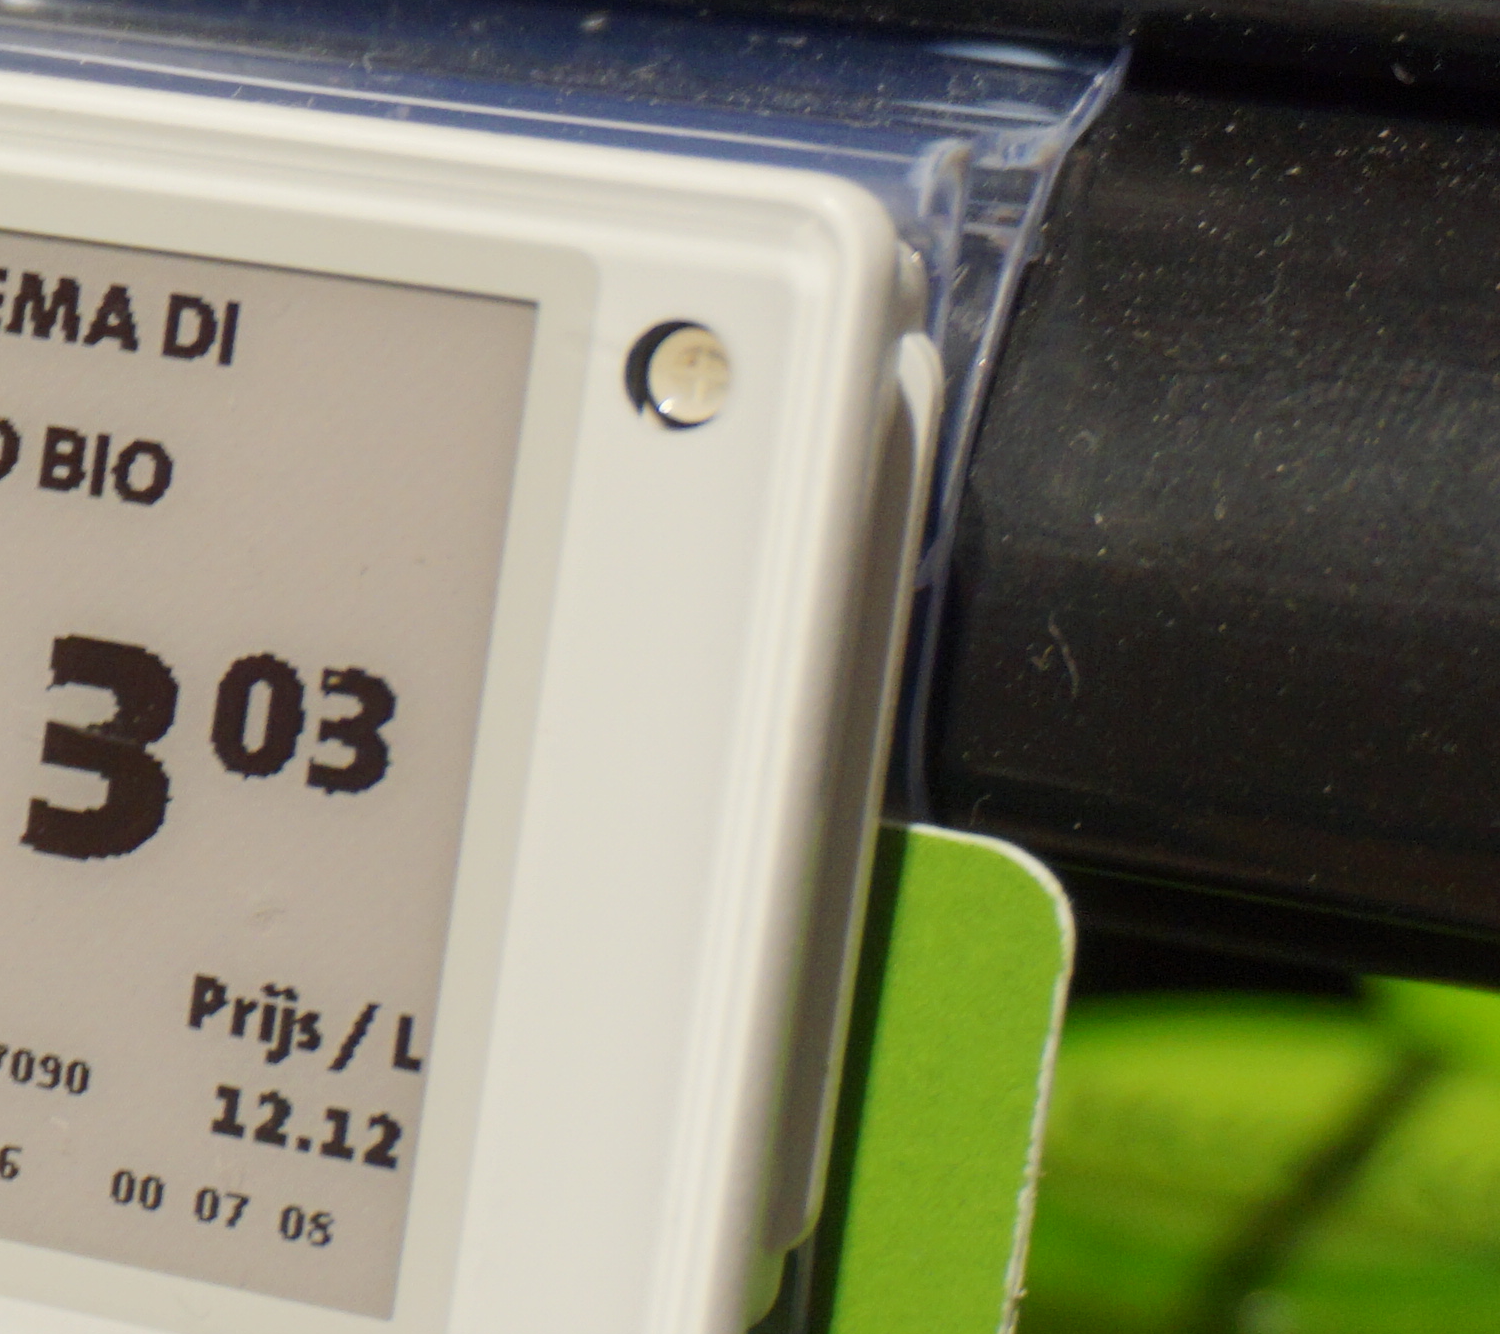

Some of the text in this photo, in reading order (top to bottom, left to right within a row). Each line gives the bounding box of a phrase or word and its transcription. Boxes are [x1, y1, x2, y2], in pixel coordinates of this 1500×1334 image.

[161, 294, 241, 366] DI
[38, 424, 174, 506] BIO
[20, 632, 398, 861] 3 03
[188, 972, 322, 1065] Prijs
[211, 1084, 402, 1170] 12.12
[110, 1169, 166, 1211] 00
[194, 1186, 249, 1228] 07
[278, 1205, 334, 1247] 08
